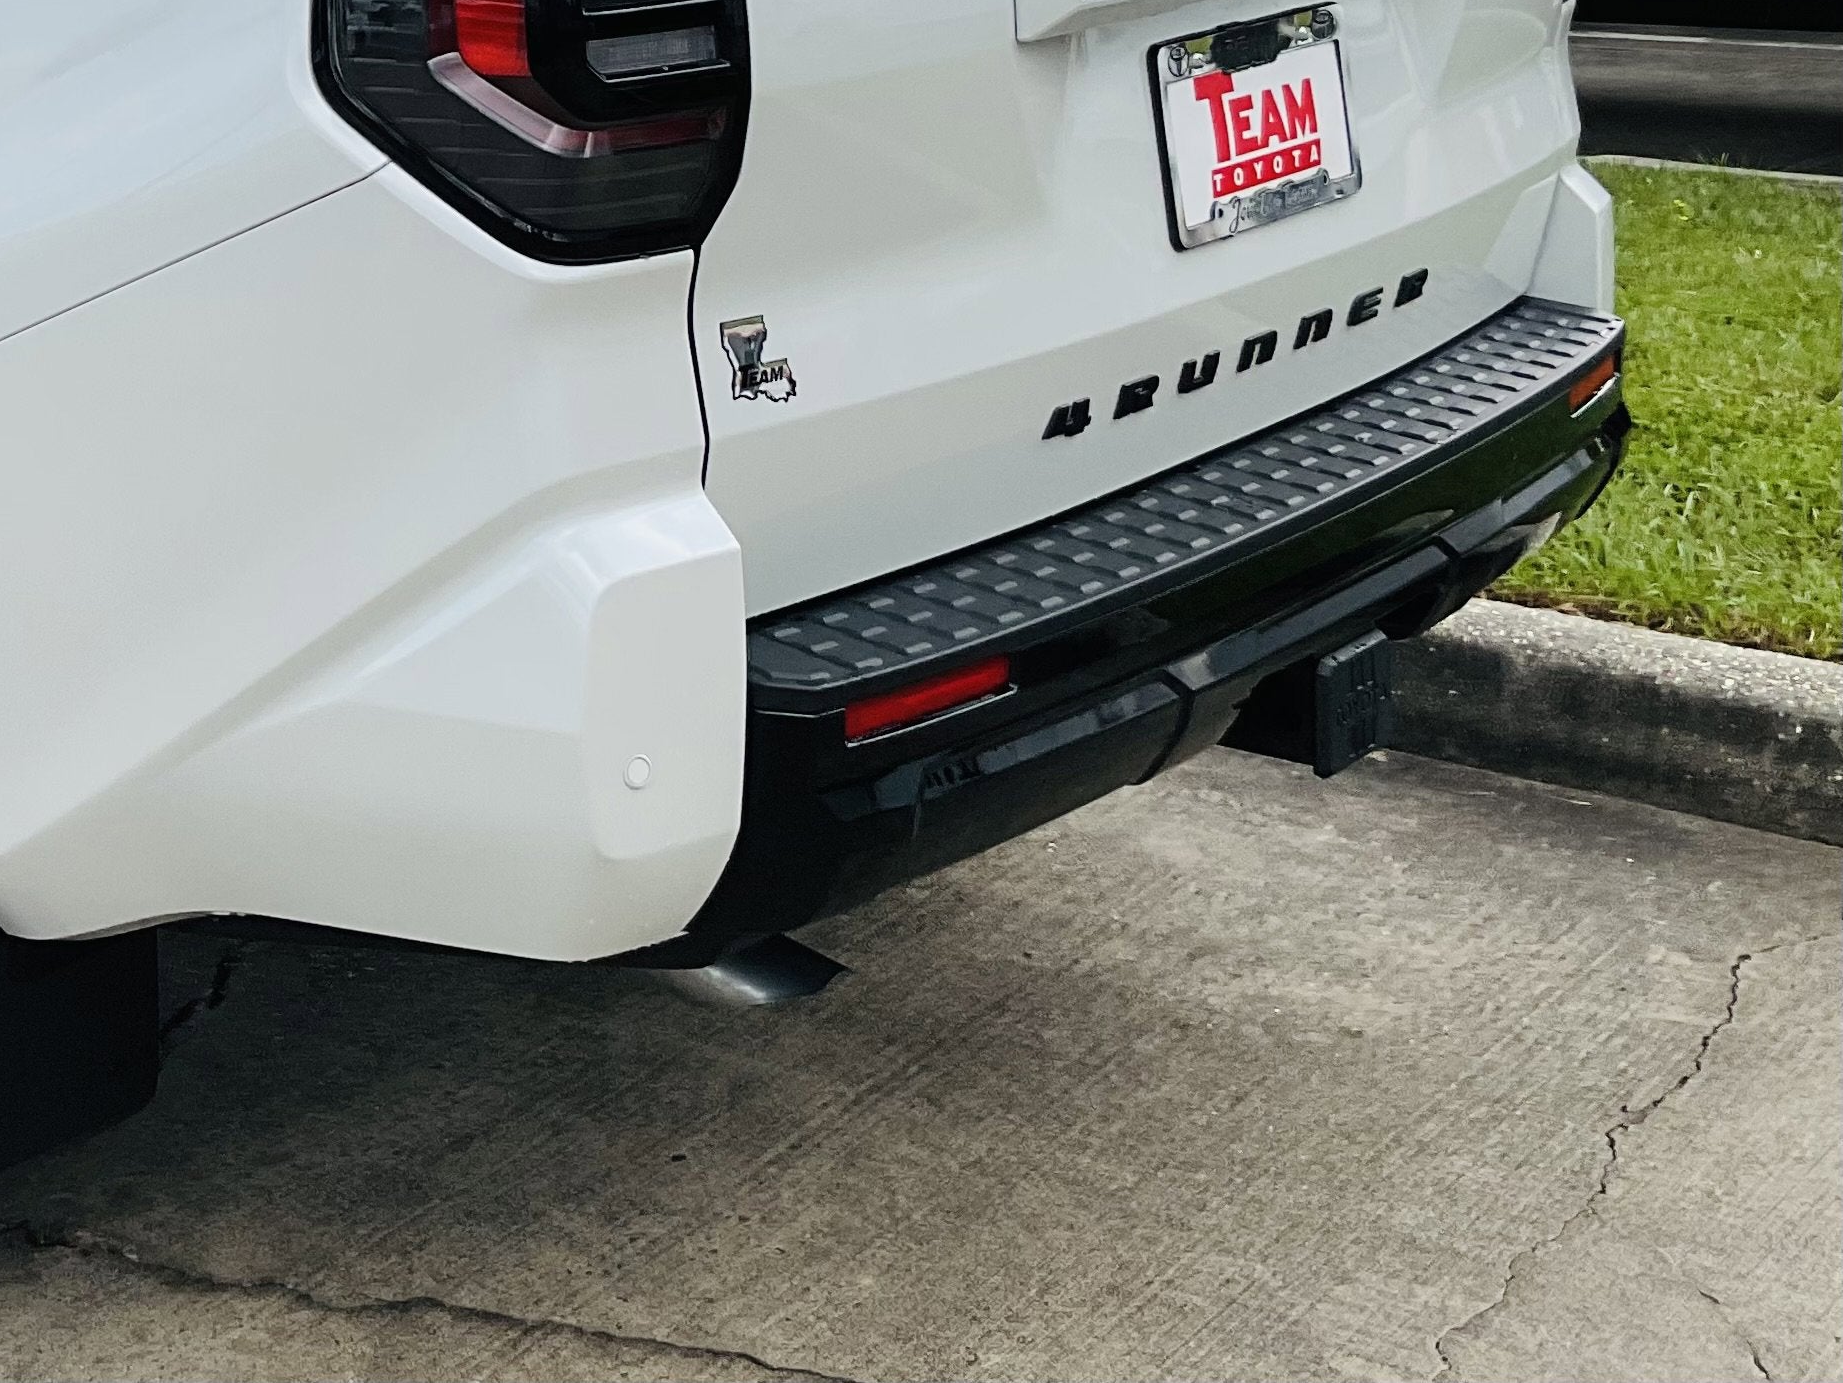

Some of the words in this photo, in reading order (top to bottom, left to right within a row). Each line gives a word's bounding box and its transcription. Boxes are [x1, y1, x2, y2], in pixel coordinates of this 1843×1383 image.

[1193, 70, 1318, 163] TEAM
[1212, 144, 1320, 193] TOYOTA
[738, 365, 784, 389] TEAM
